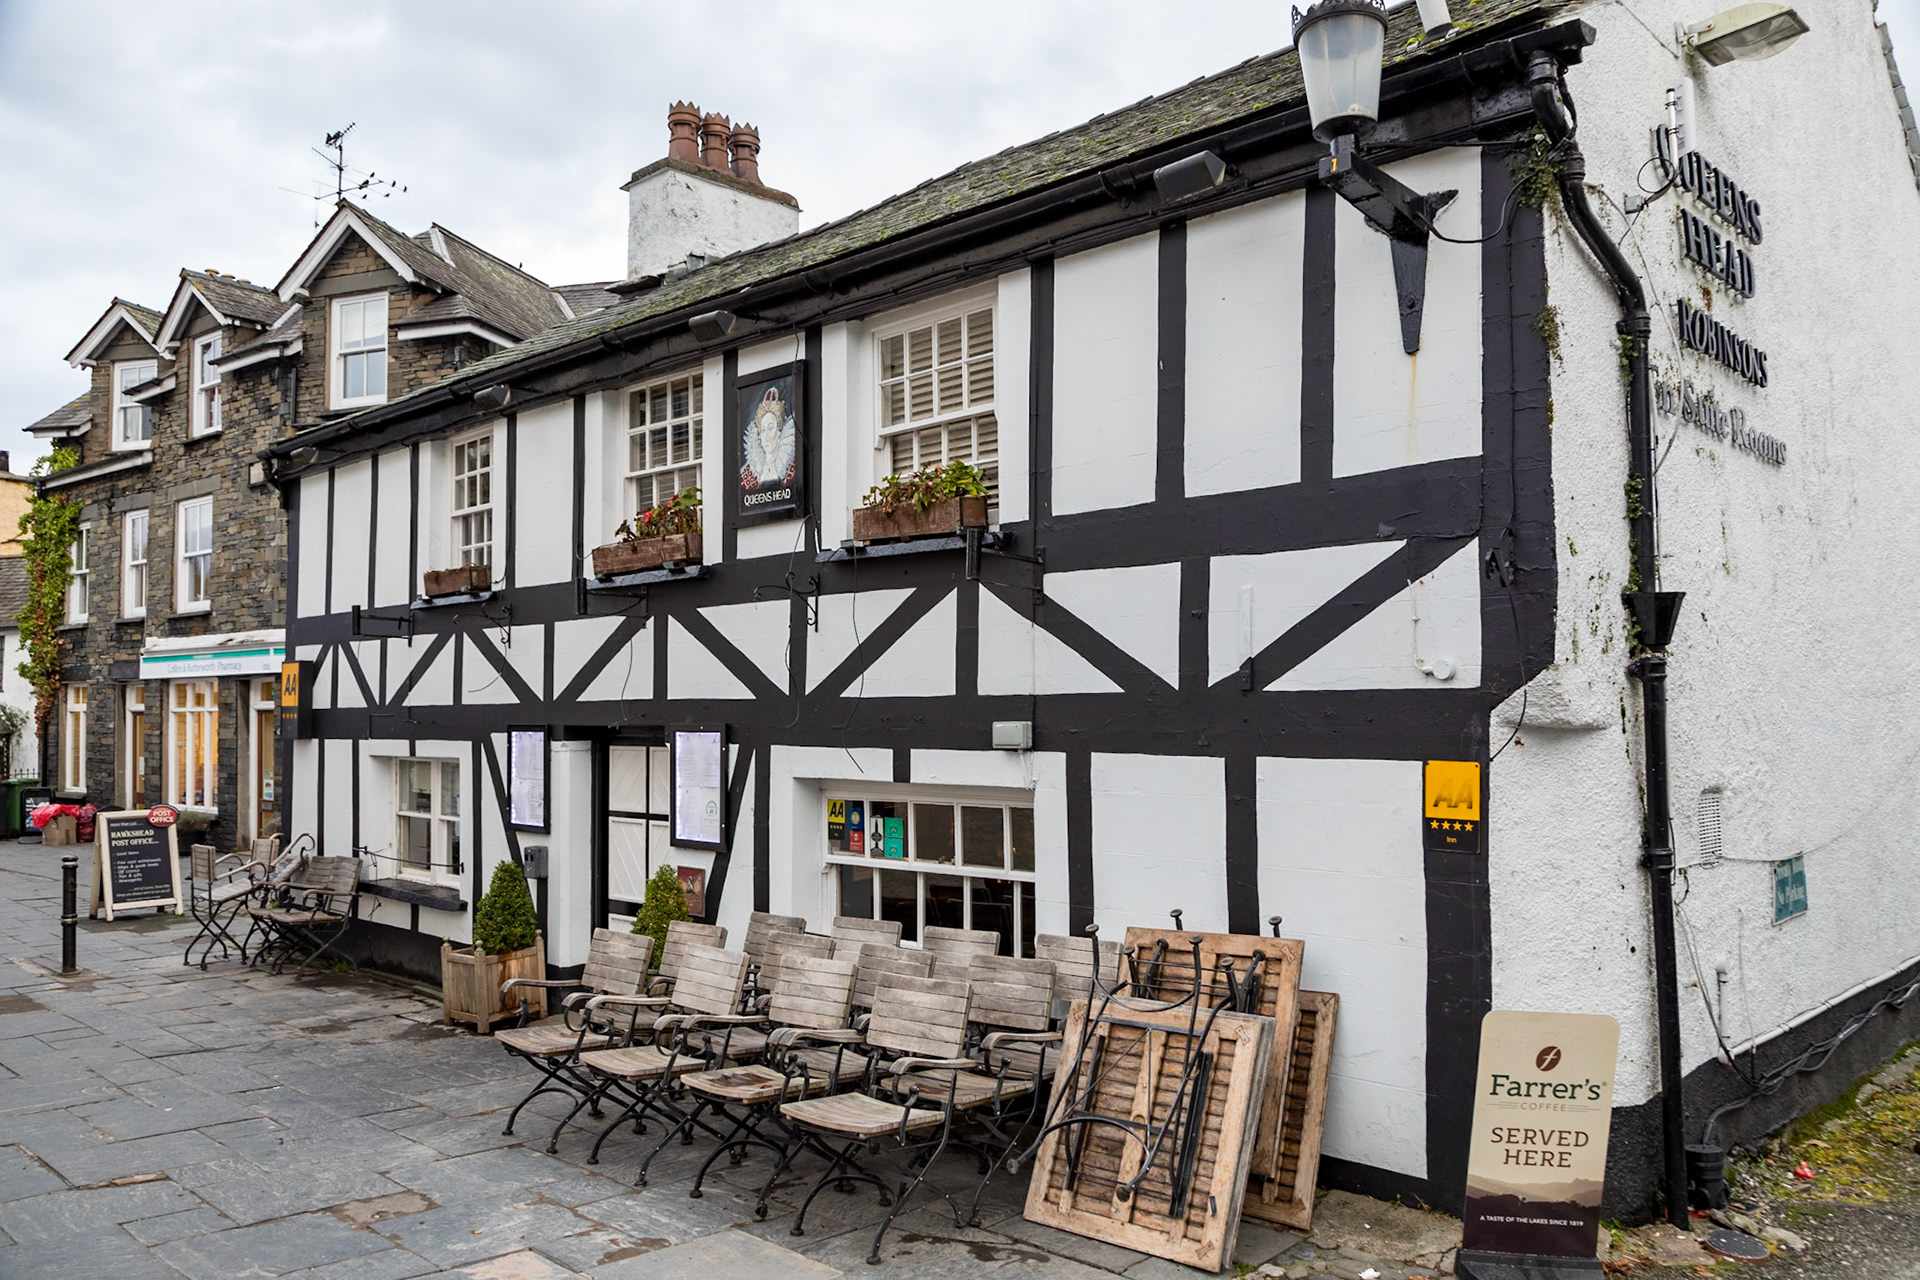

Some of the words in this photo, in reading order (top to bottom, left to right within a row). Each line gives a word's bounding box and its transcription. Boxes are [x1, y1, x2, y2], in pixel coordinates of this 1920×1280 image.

[1680, 208, 1756, 299] HEAD
[1677, 299, 1768, 388] ROBINSONS
[1682, 378, 1730, 439] Suite
[1730, 406, 1786, 466] Rooms
[744, 491, 772, 506] QUEENS
[772, 488, 791, 501] HEAD
[217, 661, 242, 672] Pharmacy
[284, 674, 296, 696] AA
[1433, 778, 1473, 809] AA
[830, 802, 844, 818] AA
[111, 830, 154, 838] HAWKSHEAD
[1489, 1074, 1600, 1100] Farrer's
[1520, 1102, 1566, 1112] COFFEE
[1490, 1128, 1589, 1147] SERVED
[1503, 1149, 1572, 1168] HERE
